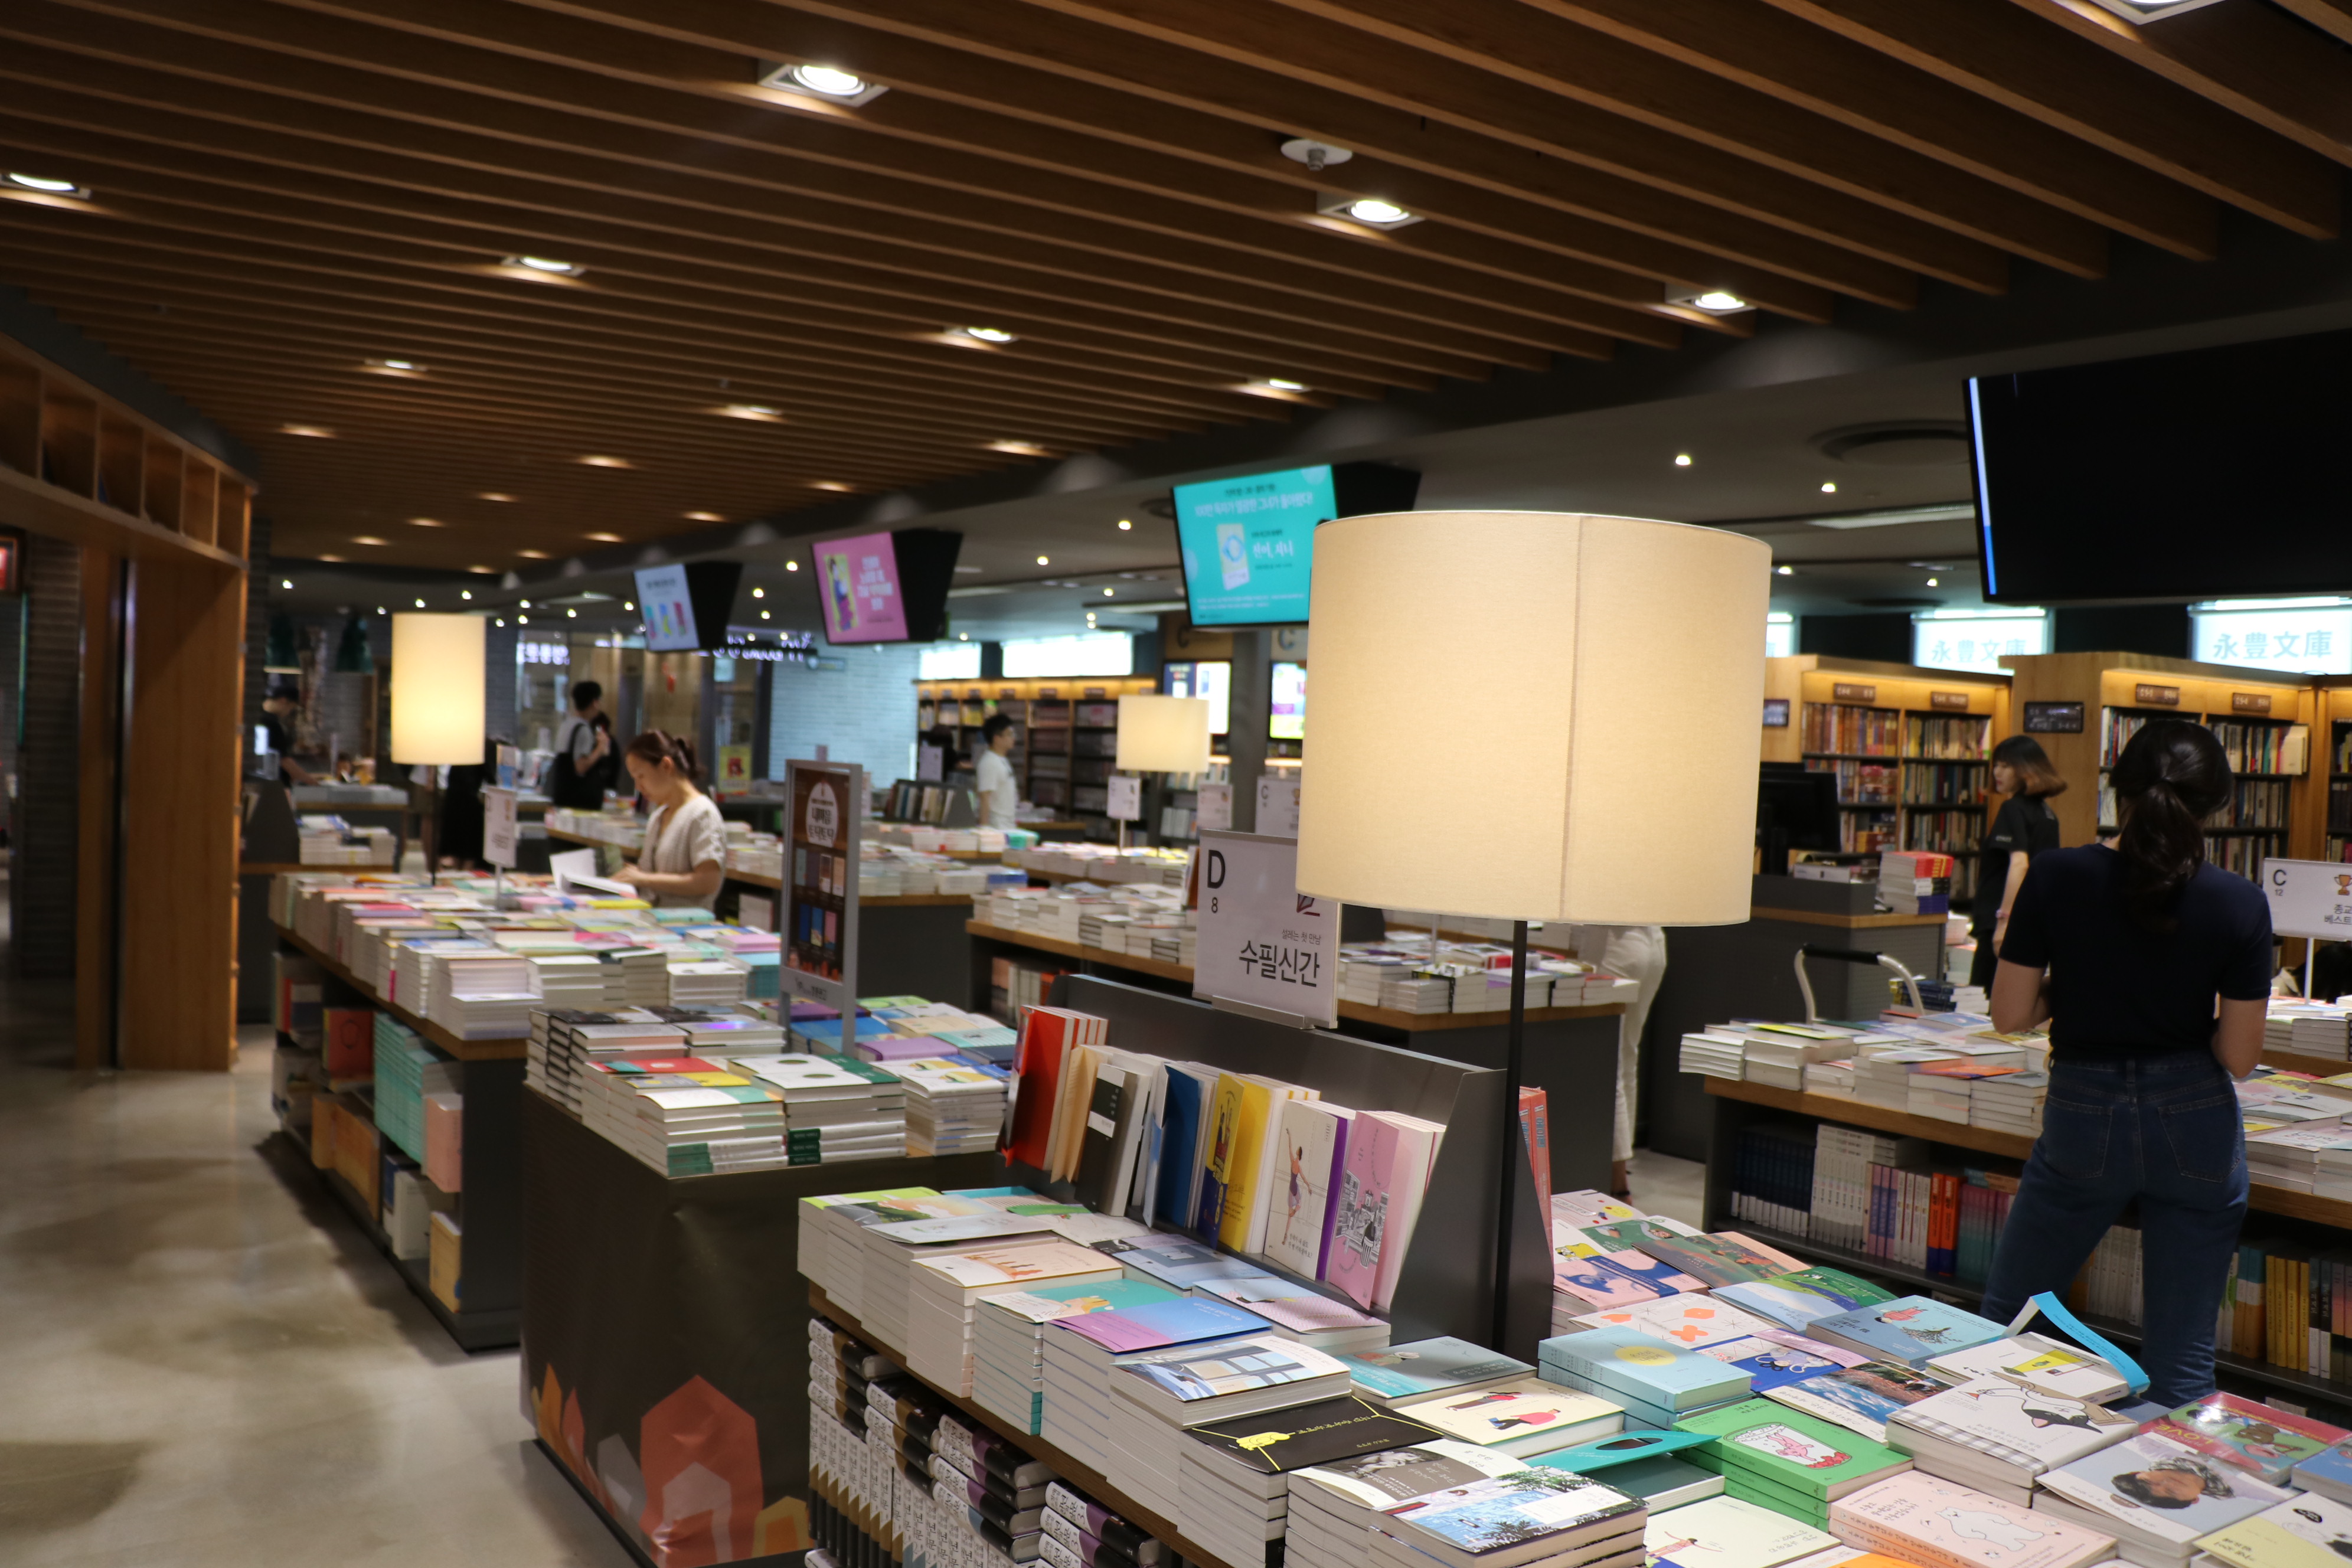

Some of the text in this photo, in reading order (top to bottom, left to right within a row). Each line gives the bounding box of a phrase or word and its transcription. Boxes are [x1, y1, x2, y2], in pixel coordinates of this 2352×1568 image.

[1207, 850, 1226, 889] D
[2273, 869, 2286, 886] C
[1211, 896, 1219, 914] 8
[1282, 928, 1322, 945] 설레는 첫 만남
[1239, 939, 1320, 988] 수필신간
[2155, 1423, 2216, 1446] LOVE
